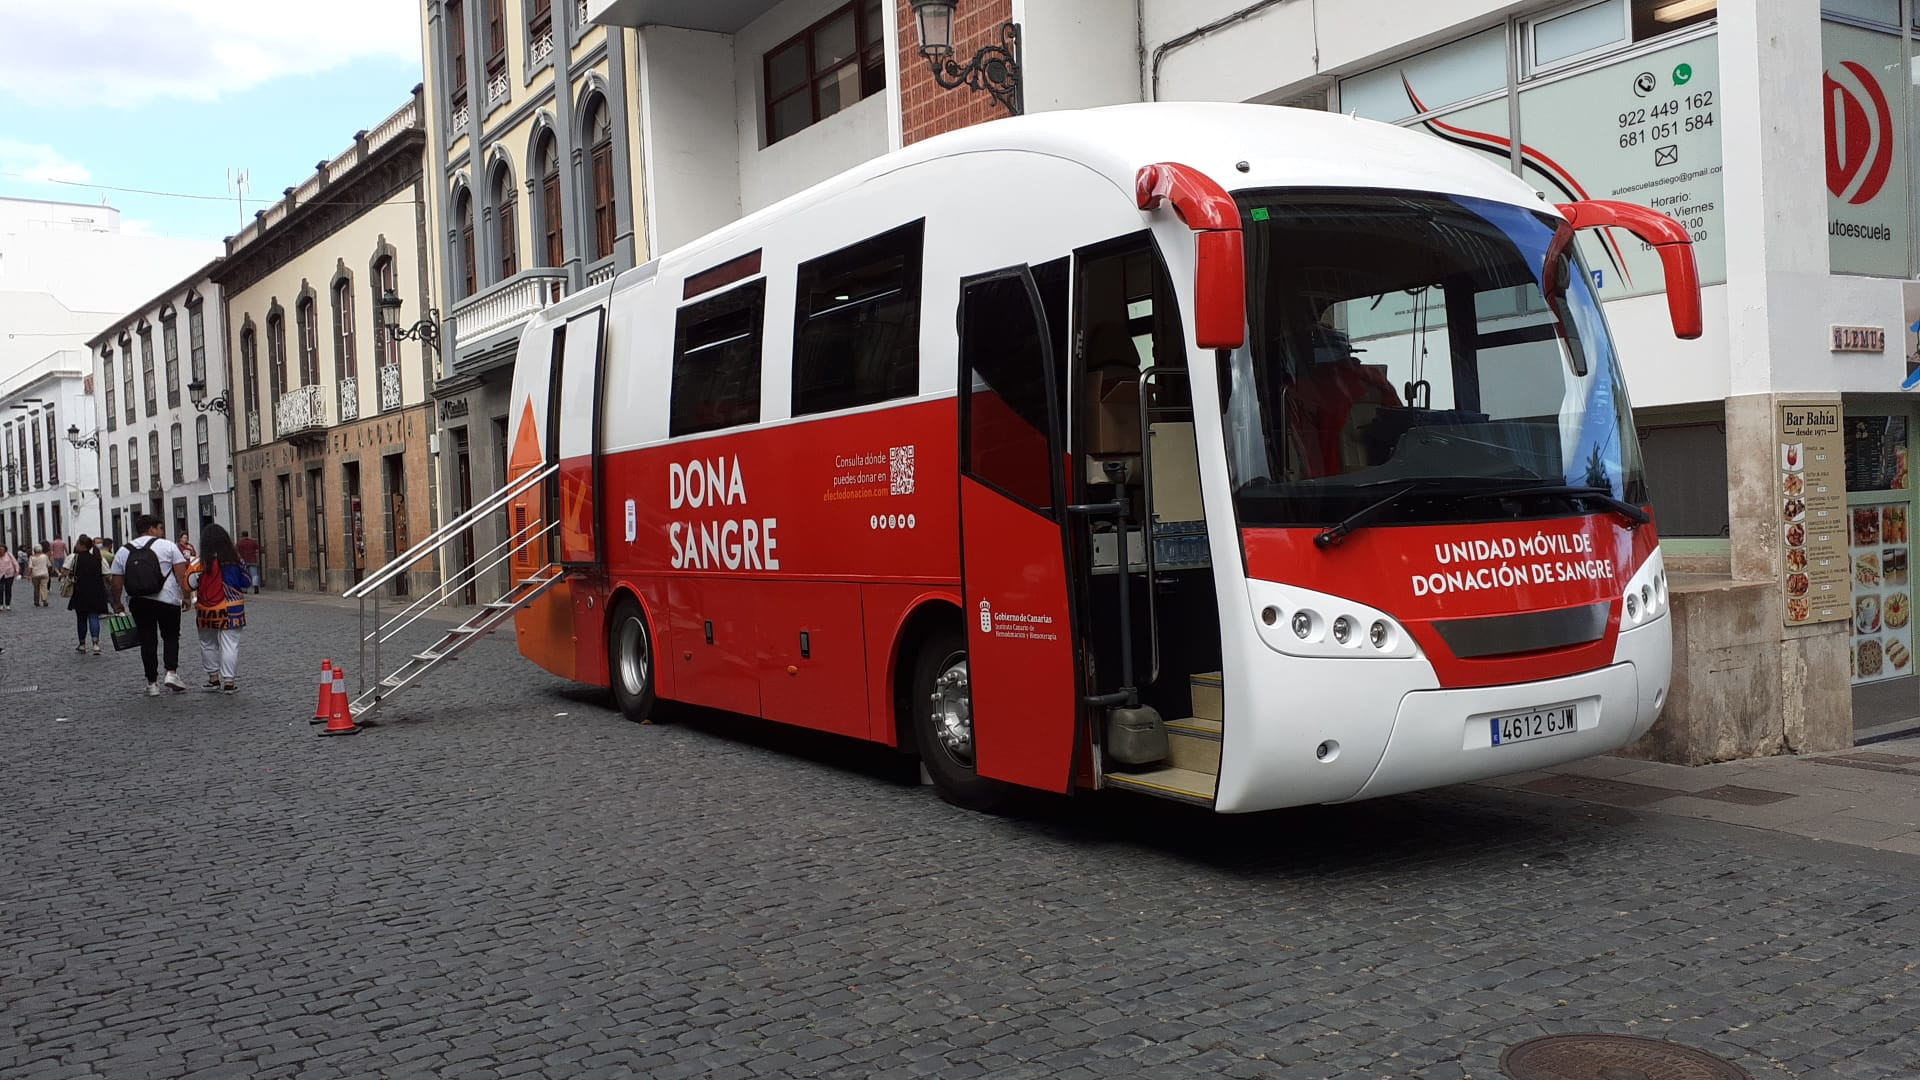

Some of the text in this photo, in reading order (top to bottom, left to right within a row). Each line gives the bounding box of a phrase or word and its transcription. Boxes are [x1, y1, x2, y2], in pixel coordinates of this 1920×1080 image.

[1619, 91, 1712, 128] 922 449 162
[1620, 112, 1714, 148] 681 051 584
[1651, 193, 1692, 208] Horario:
[1674, 202, 1714, 217] Viernes
[1680, 216, 1704, 230] 3:00
[1828, 219, 1890, 240] utoescuela
[1786, 410, 1835, 426] Bar Bahía
[1796, 428, 1827, 437] desde 1971
[836, 451, 886, 468] Consulta dónde
[670, 452, 747, 510] DONA
[834, 470, 887, 488] puedes donar en
[670, 517, 780, 571] SANGRE
[1434, 530, 1593, 564] UNIDAD MÓVIL DE
[1412, 559, 1613, 597] DONACIÓN DE SANGRE
[994, 612, 1052, 623] Gobierno de Canarias
[1503, 708, 1574, 740] 4612 GJW
